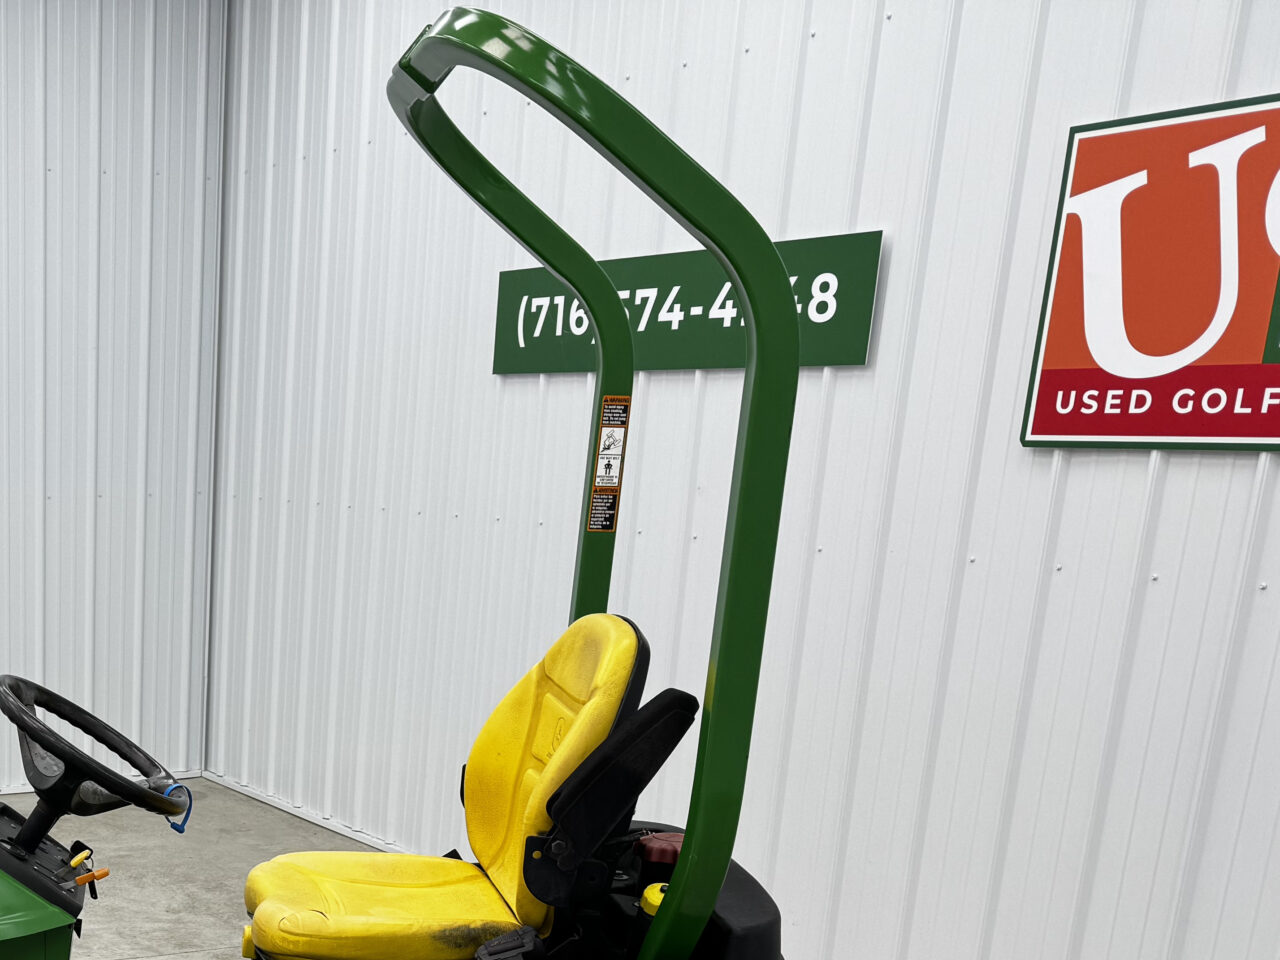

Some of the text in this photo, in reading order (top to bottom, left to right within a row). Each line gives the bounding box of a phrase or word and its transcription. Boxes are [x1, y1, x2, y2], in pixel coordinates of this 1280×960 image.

[1065, 125, 1280, 379] U
[517, 295, 597, 348] (716
[1055, 387, 1280, 415] USED GOLF
